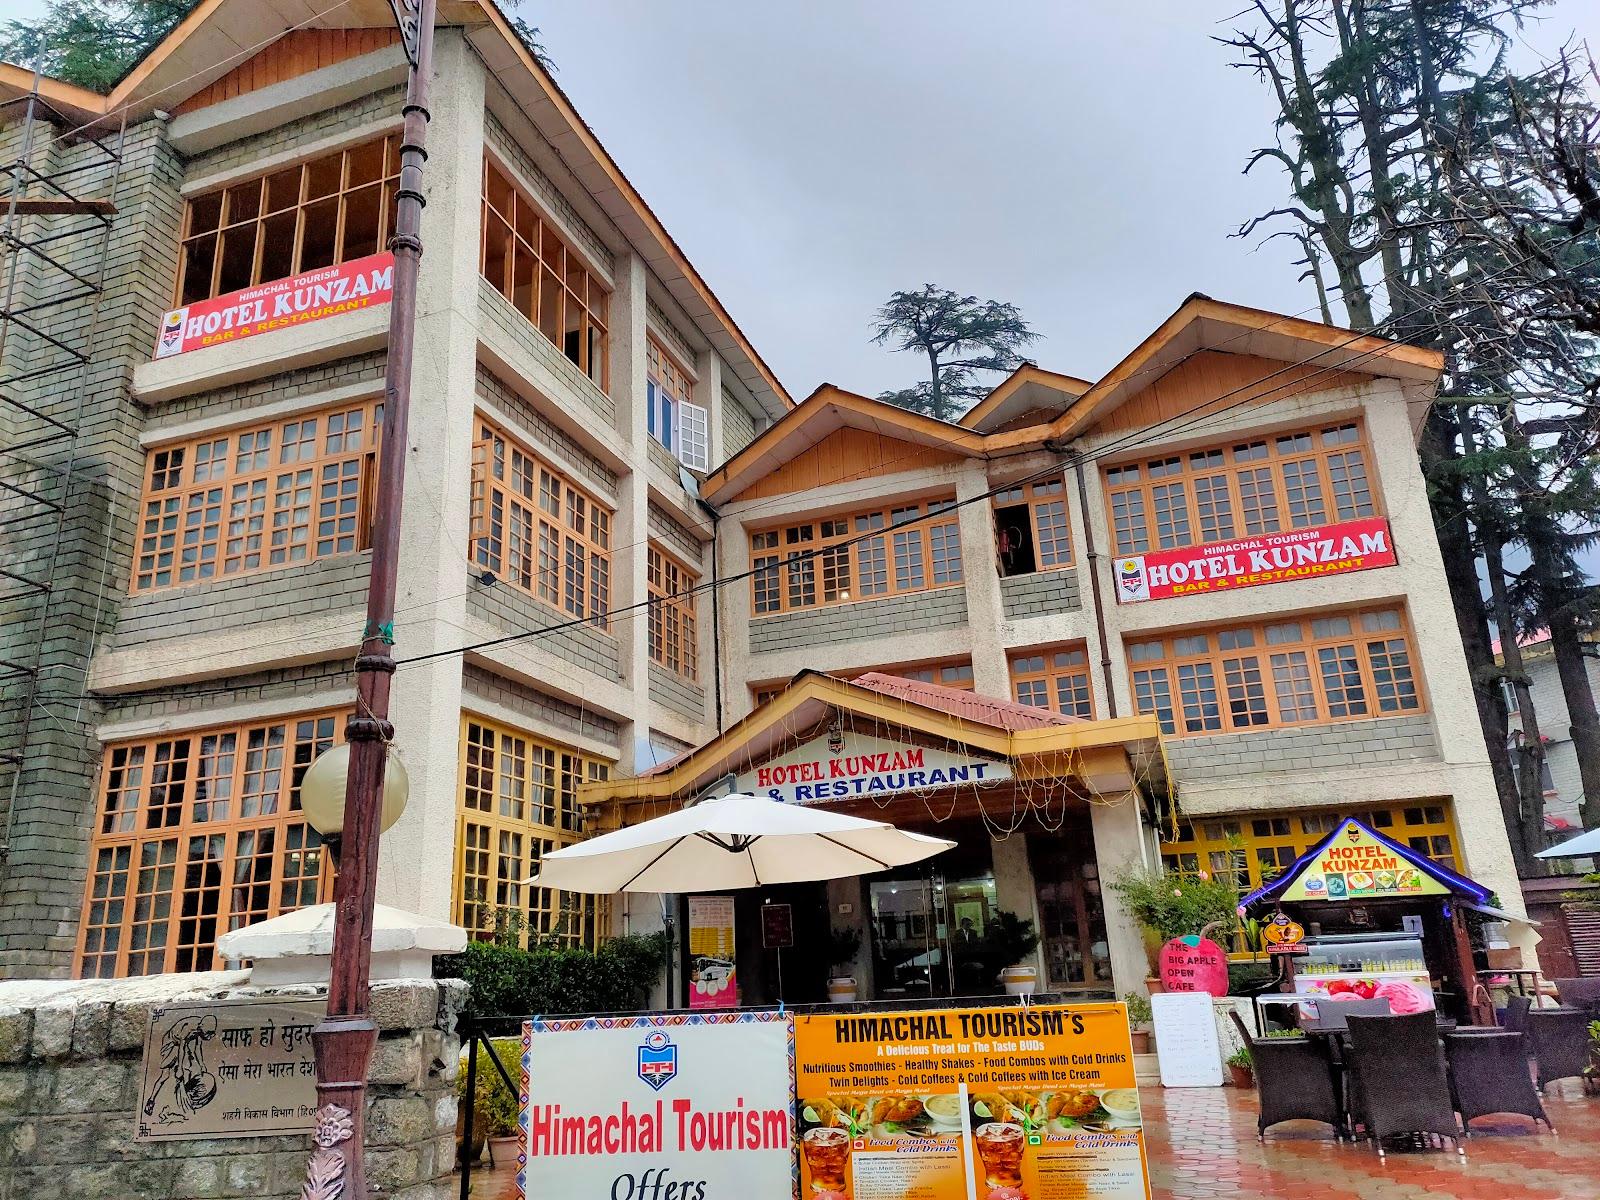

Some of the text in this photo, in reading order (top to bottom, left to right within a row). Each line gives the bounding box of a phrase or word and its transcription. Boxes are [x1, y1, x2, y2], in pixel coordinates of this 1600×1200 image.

[239, 269, 340, 302] HIMACHAL TOURISM
[184, 265, 393, 340] HOTEL KUNZAM
[201, 297, 371, 345] BAR & RESTAURANT
[1203, 531, 1320, 556] HIMACHAL TOURISM
[1148, 530, 1388, 587] HOTEL KUNZAM
[1172, 558, 1365, 593] BAR & RESTAURANT
[757, 749, 925, 788] HOTEL KUNZAM
[768, 762, 990, 802] & RESTAURANT
[1322, 845, 1398, 873] HOTEL KUNZAM
[1168, 955, 1217, 965] BIG APPLE
[1169, 943, 1189, 952] THE
[1167, 968, 1194, 977] OPEN
[1168, 982, 1195, 991] CAFE
[222, 1017, 315, 1052] साफ हो सुंदर
[835, 1014, 952, 1043] HIMACHAL
[877, 1039, 1045, 1056] A Delicious Treat for The Taste BUDs
[218, 1060, 239, 1084] ऐसा
[244, 1058, 262, 1079] मेरा
[268, 1062, 295, 1078] भारत
[803, 1062, 846, 1074] Nutritious
[849, 1061, 896, 1073] Smoothies
[905, 1059, 939, 1071] Healthy
[941, 1058, 975, 1070] Shakes
[984, 1057, 1006, 1068] Food
[1008, 1056, 1046, 1067] Combos
[1049, 1055, 1069, 1066] with
[1071, 1054, 1093, 1065] Cold
[1095, 1052, 1126, 1064] Drinks
[829, 1077, 850, 1087] Twin
[852, 1075, 889, 1088] Delights
[898, 1074, 919, 1085] Cold
[921, 1073, 955, 1085] Coffees
[958, 1073, 965, 1083] &
[968, 1072, 989, 1083] Cold
[991, 1071, 1026, 1082] Coffees
[1028, 1070, 1049, 1081] with
[1051, 1069, 1067, 1080] Ice
[1069, 1069, 1101, 1080] Cream
[222, 1107, 241, 1120] शहरी
[244, 1106, 268, 1120] विकास
[271, 1105, 294, 1119] विभाग
[531, 1097, 788, 1157] Himachal Tourism
[1046, 1134, 1073, 1142] Food
[1073, 1133, 1117, 1141] Combos
[895, 1137, 937, 1145] Combos
[1074, 1140, 1139, 1149] Cold Drinks
[610, 1167, 707, 1200] Offers
